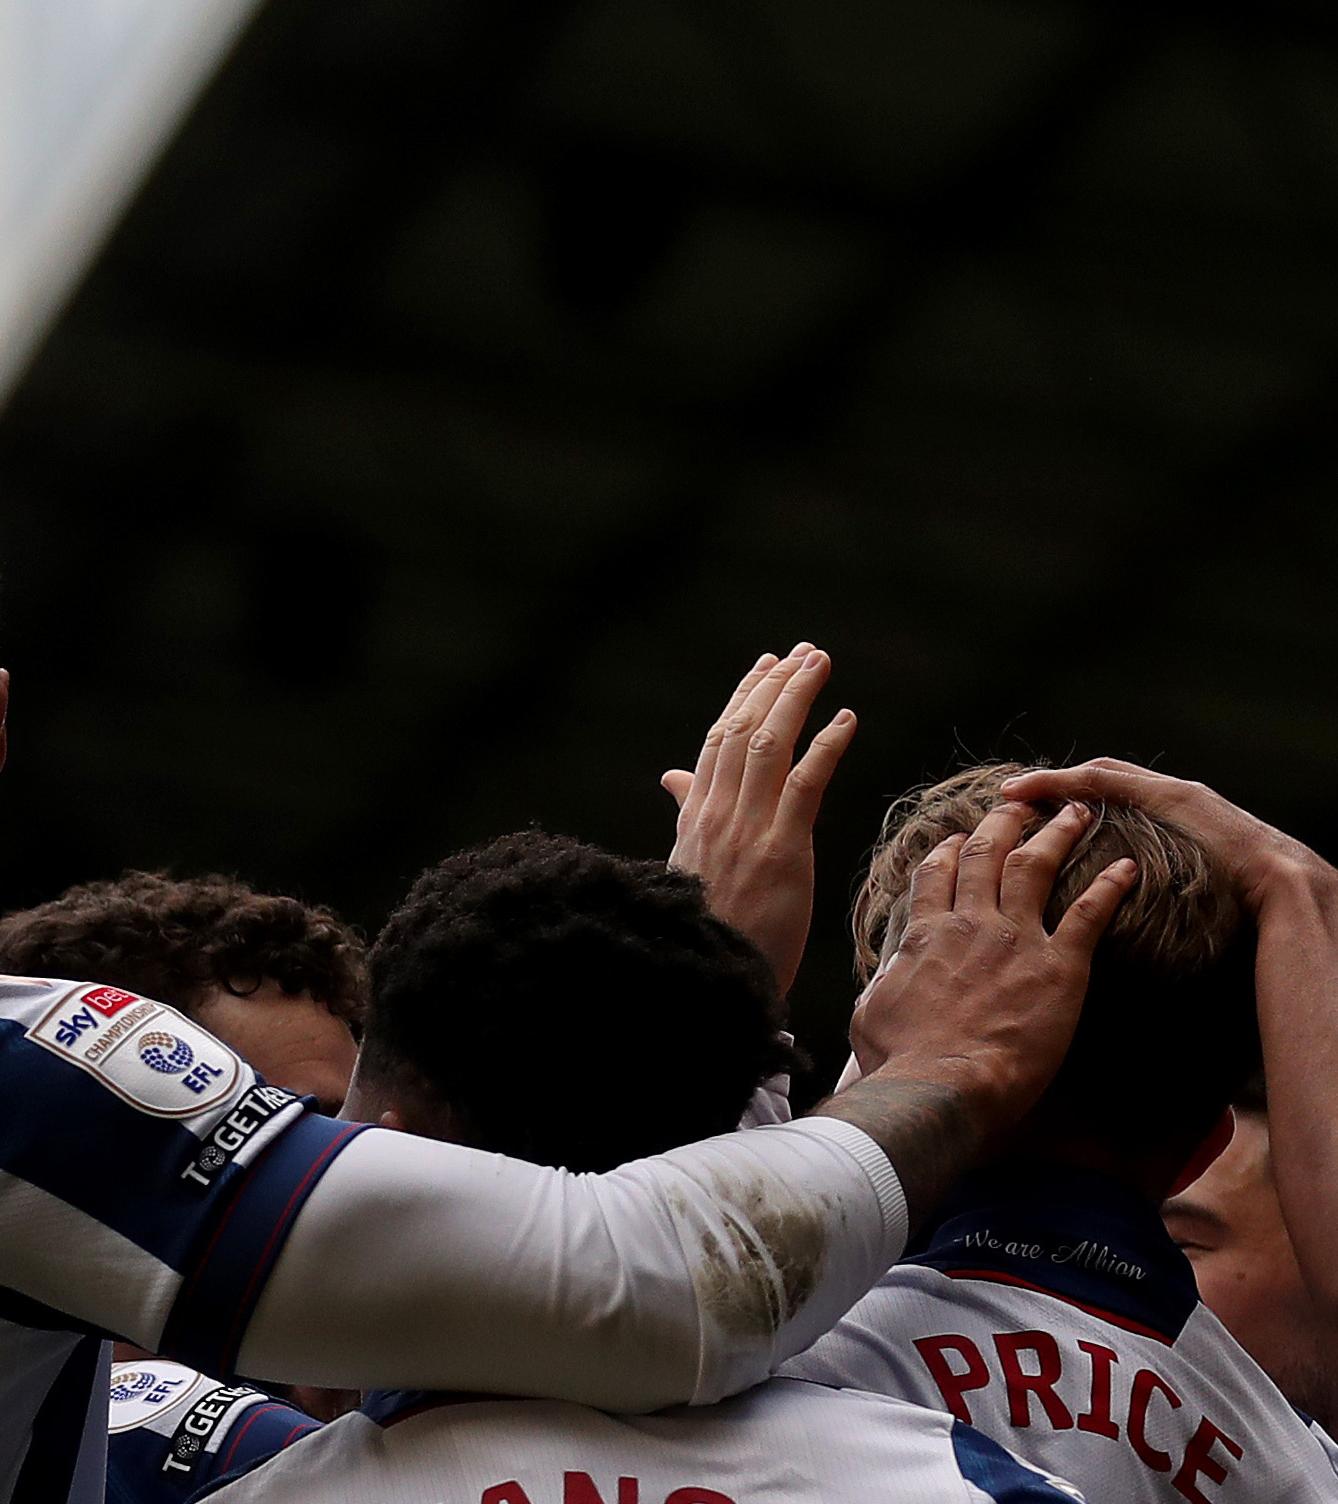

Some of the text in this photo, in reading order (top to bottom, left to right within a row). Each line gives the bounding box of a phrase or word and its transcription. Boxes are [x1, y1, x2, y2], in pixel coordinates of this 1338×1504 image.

[56, 988, 129, 1047] sky bet
[182, 1062, 223, 1094] EFL
[1005, 1241, 1044, 1259] are
[1050, 1240, 1147, 1281] Albion
[145, 1379, 184, 1403] EFL
